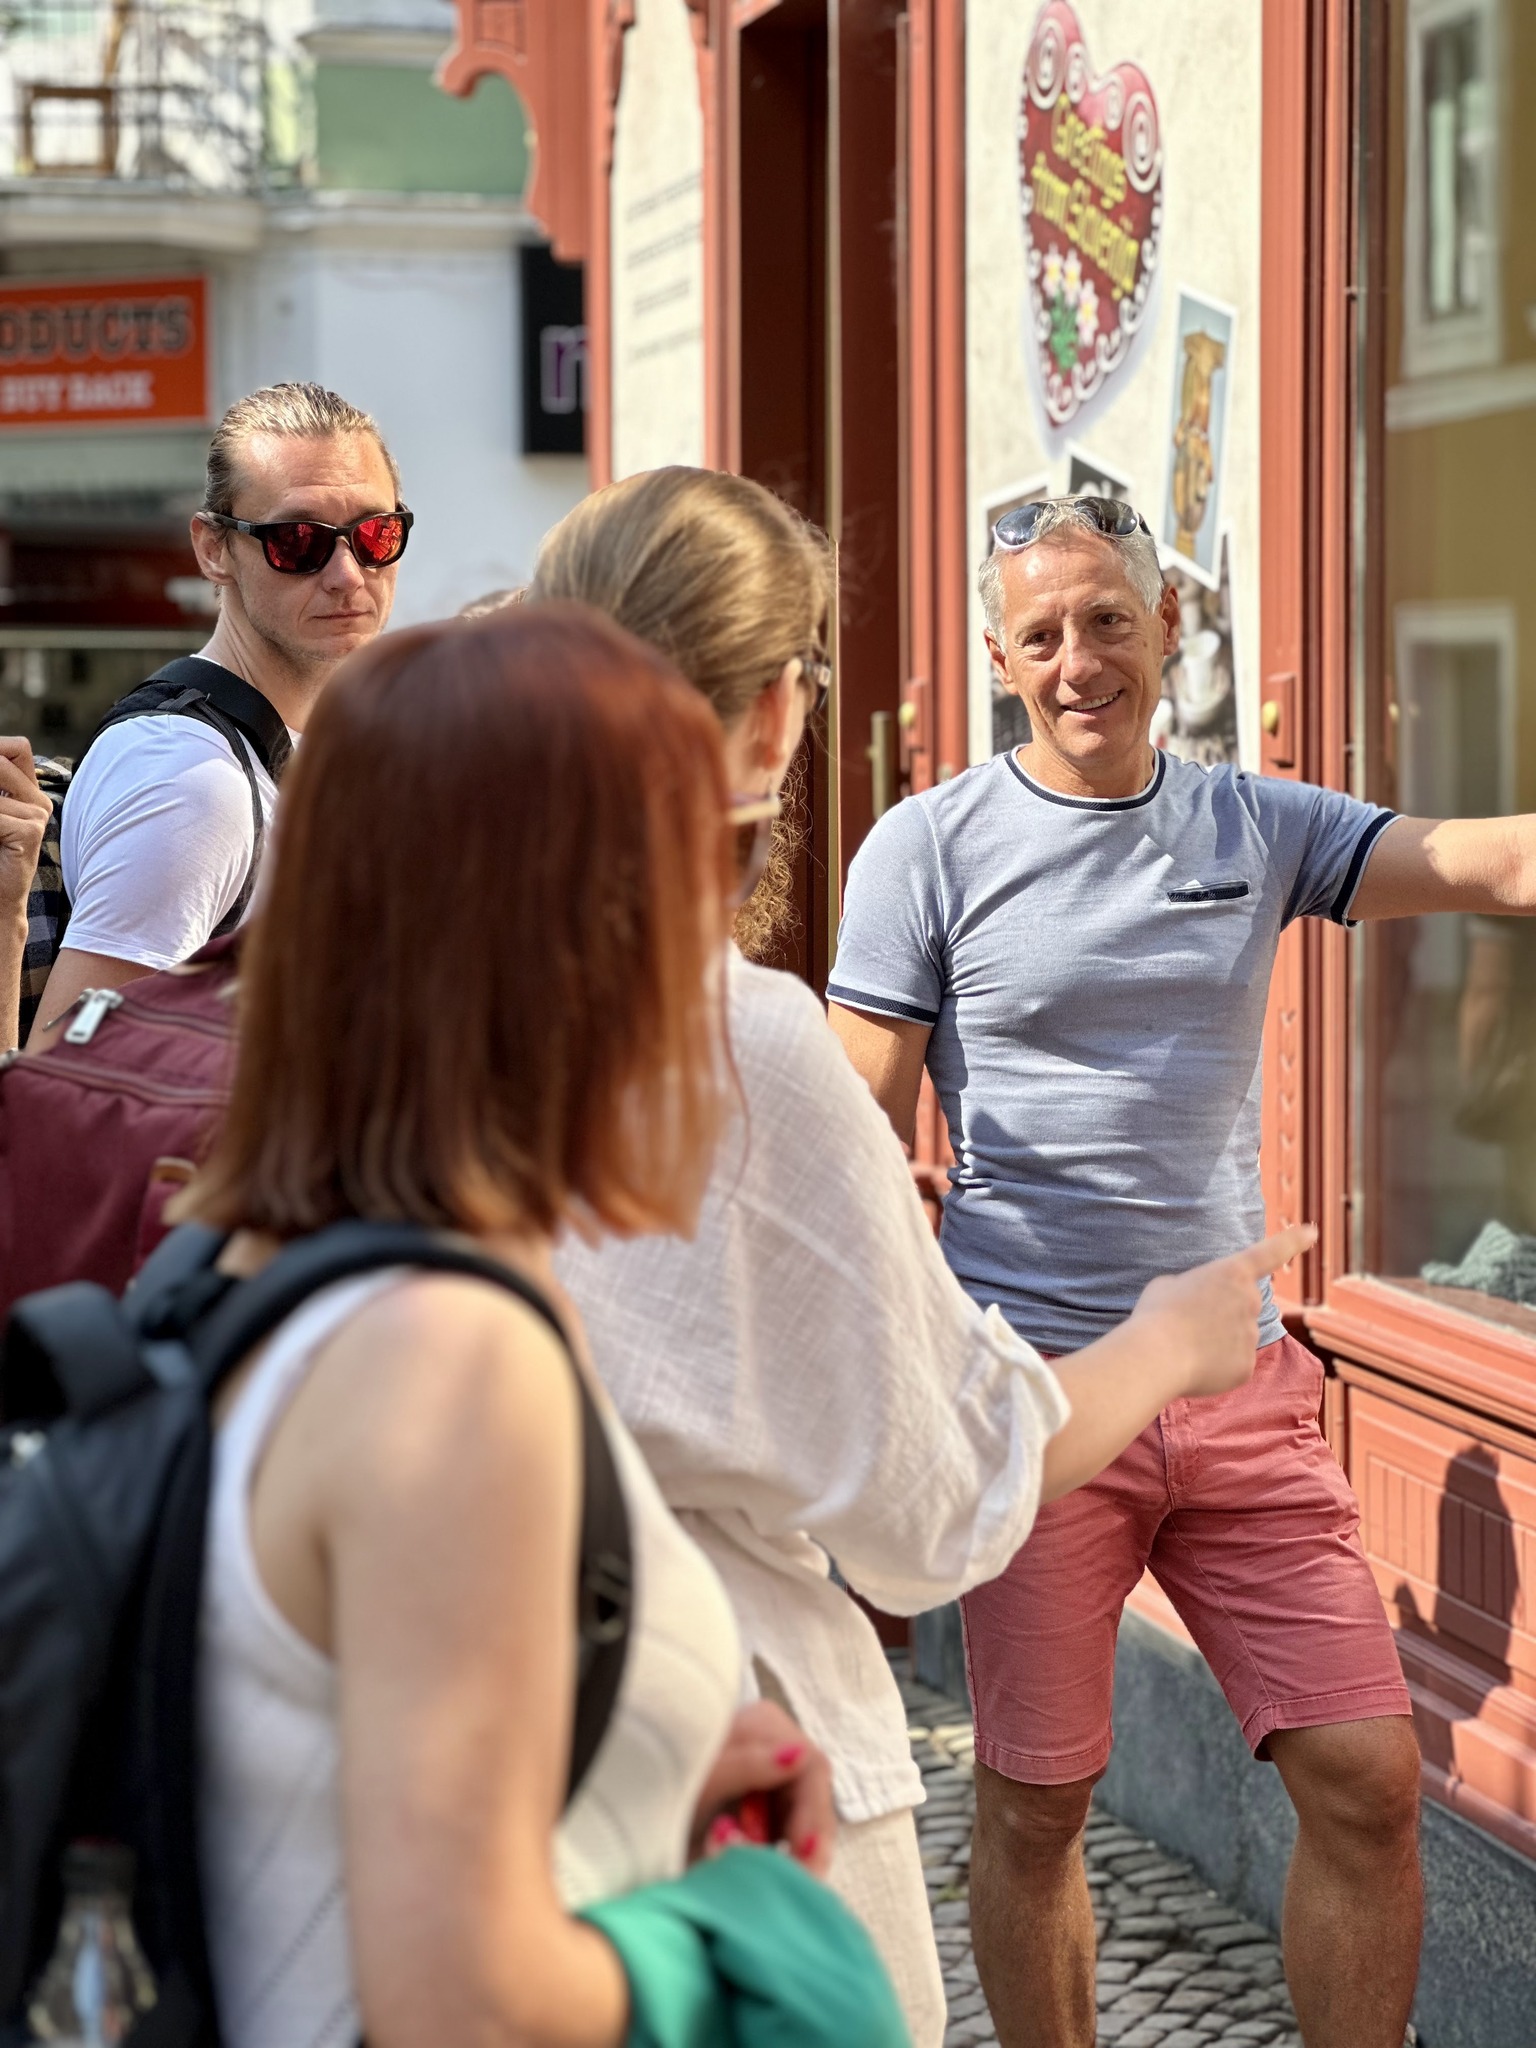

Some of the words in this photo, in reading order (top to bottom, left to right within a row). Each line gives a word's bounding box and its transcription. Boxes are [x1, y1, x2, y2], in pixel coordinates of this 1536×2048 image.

[1031, 151, 1071, 232] from
[1052, 92, 1127, 210] Greetings
[66, 370, 156, 412] BACK
